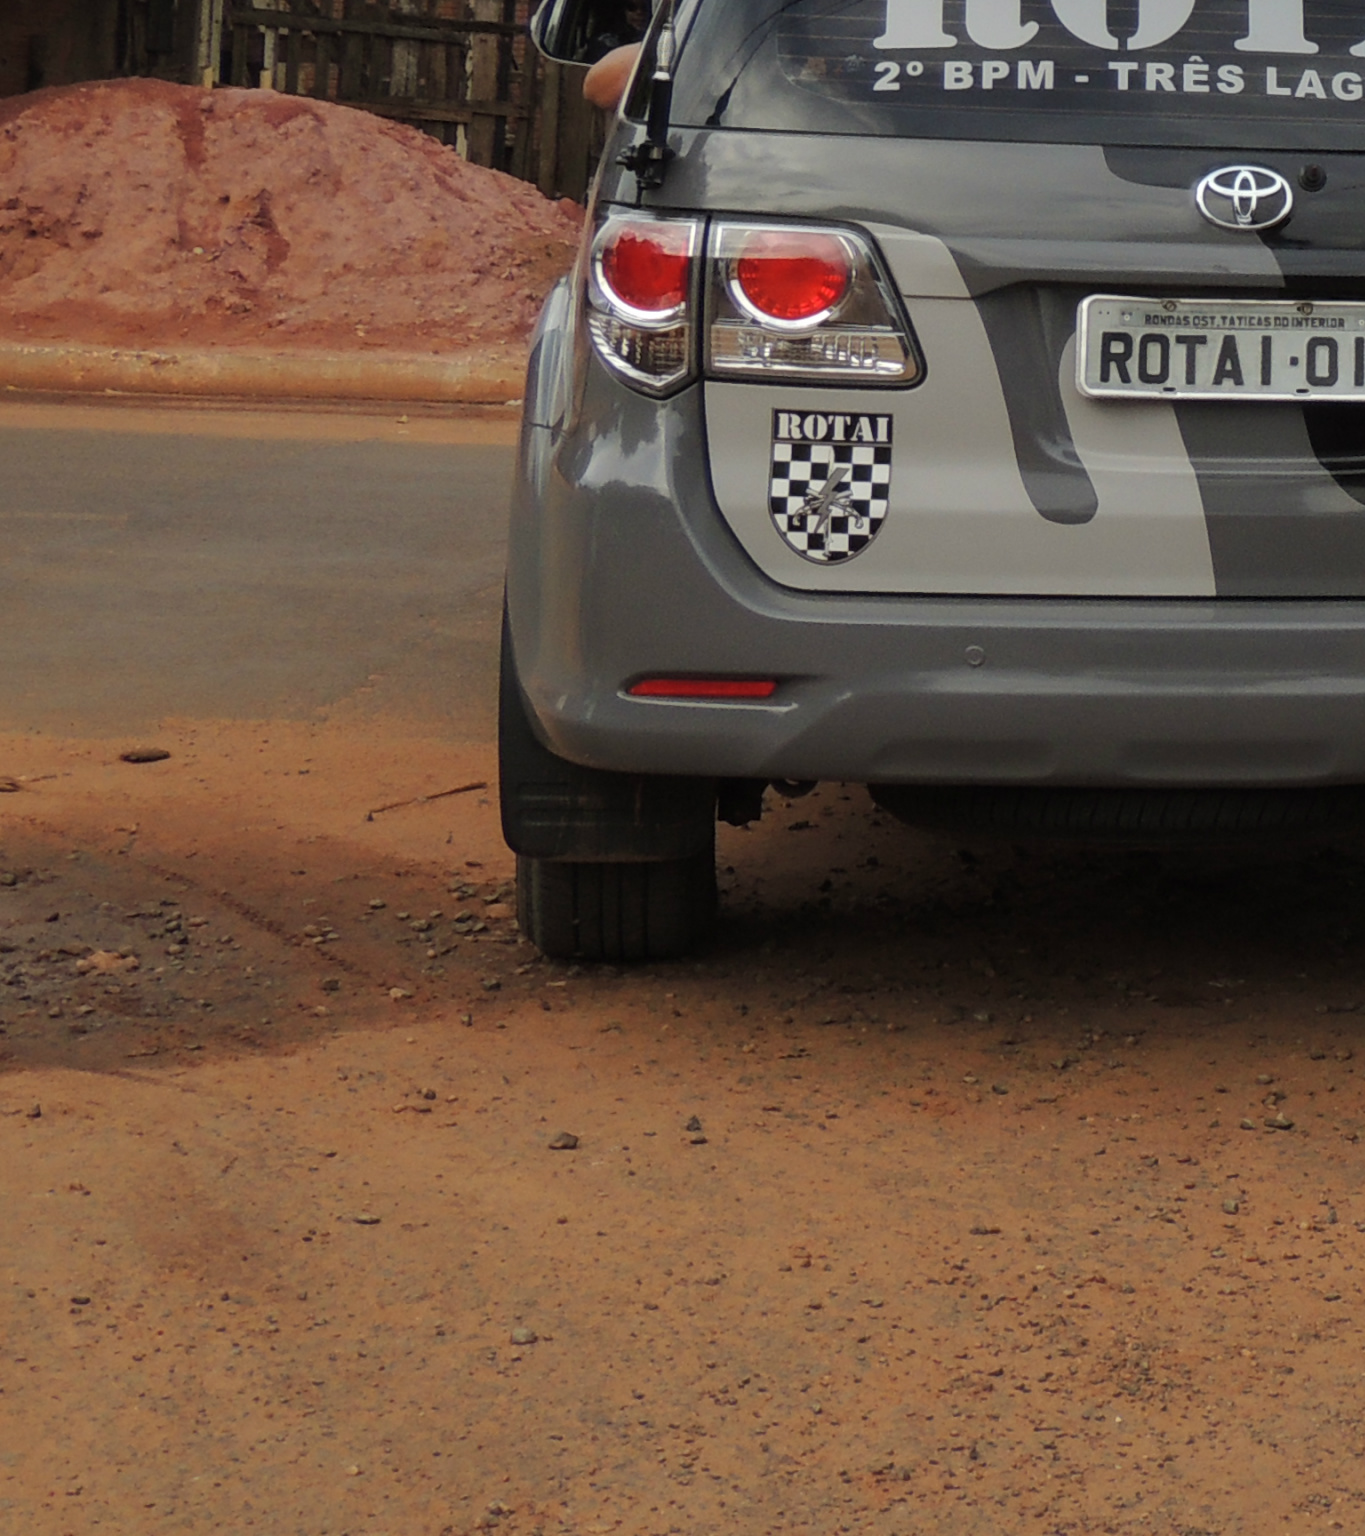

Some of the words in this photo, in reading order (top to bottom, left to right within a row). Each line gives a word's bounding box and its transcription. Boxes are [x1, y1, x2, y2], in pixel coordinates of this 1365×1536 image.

[943, 60, 1056, 92] BPM
[1107, 54, 1246, 96] TRÊS
[1145, 315, 1190, 329] RONDAS
[1274, 317, 1289, 330] DO
[1291, 317, 1345, 332] INTERIOR
[777, 412, 889, 442] ROTAI
